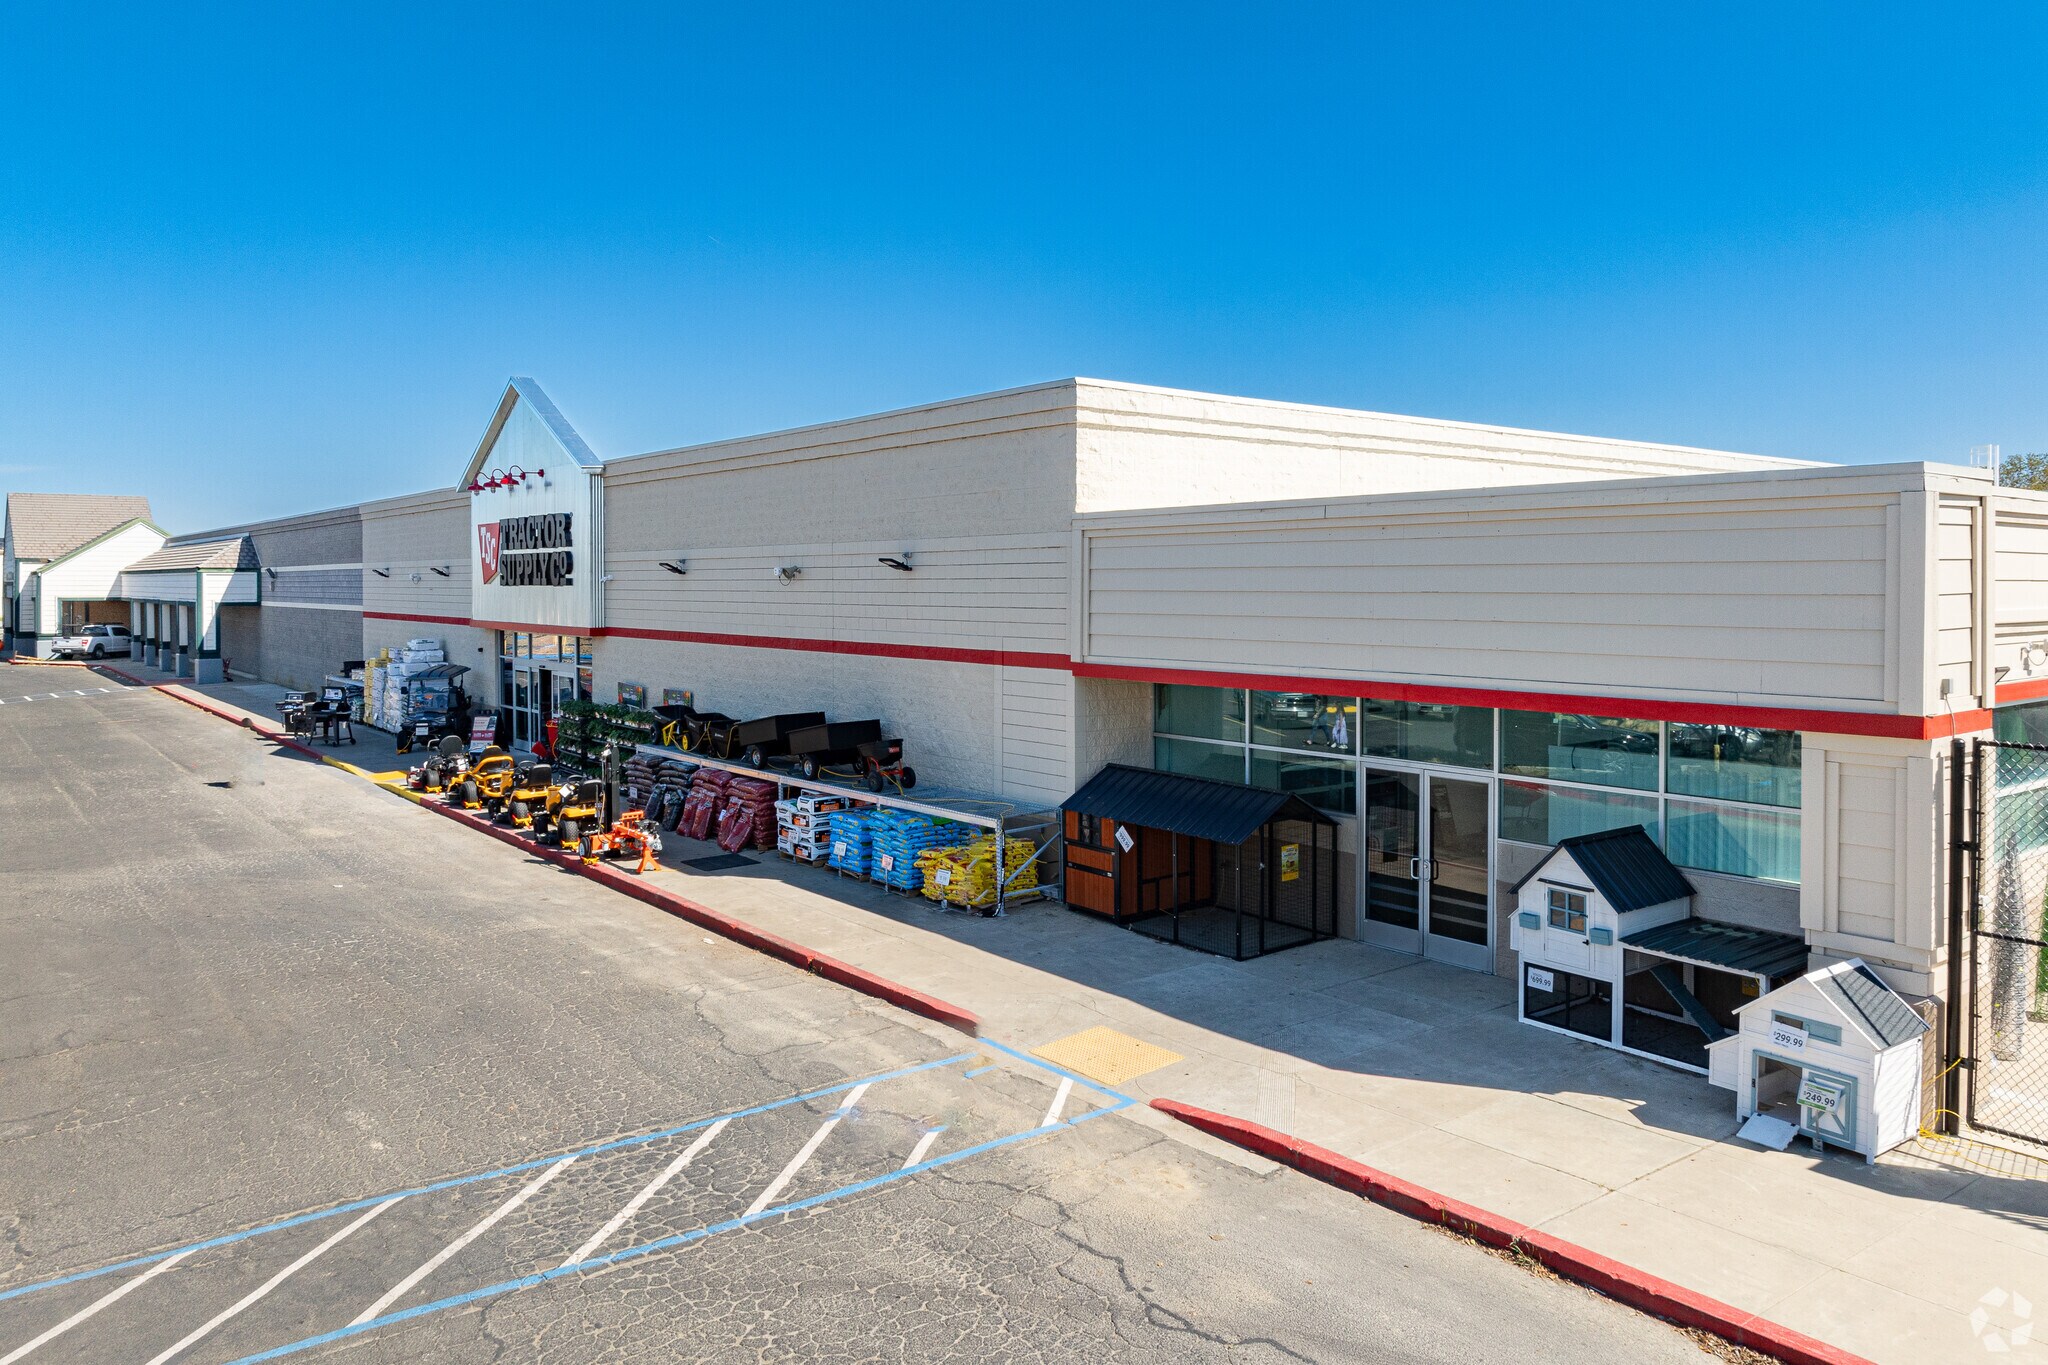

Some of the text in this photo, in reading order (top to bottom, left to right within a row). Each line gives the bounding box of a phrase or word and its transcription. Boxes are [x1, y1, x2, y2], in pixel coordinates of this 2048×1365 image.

[480, 526, 496, 571] TSC
[500, 513, 566, 550] TRACTOR
[500, 552, 548, 587] SUPPLY
[1773, 1031, 1804, 1047] $299.99
[1803, 1091, 1836, 1107] $249.99
